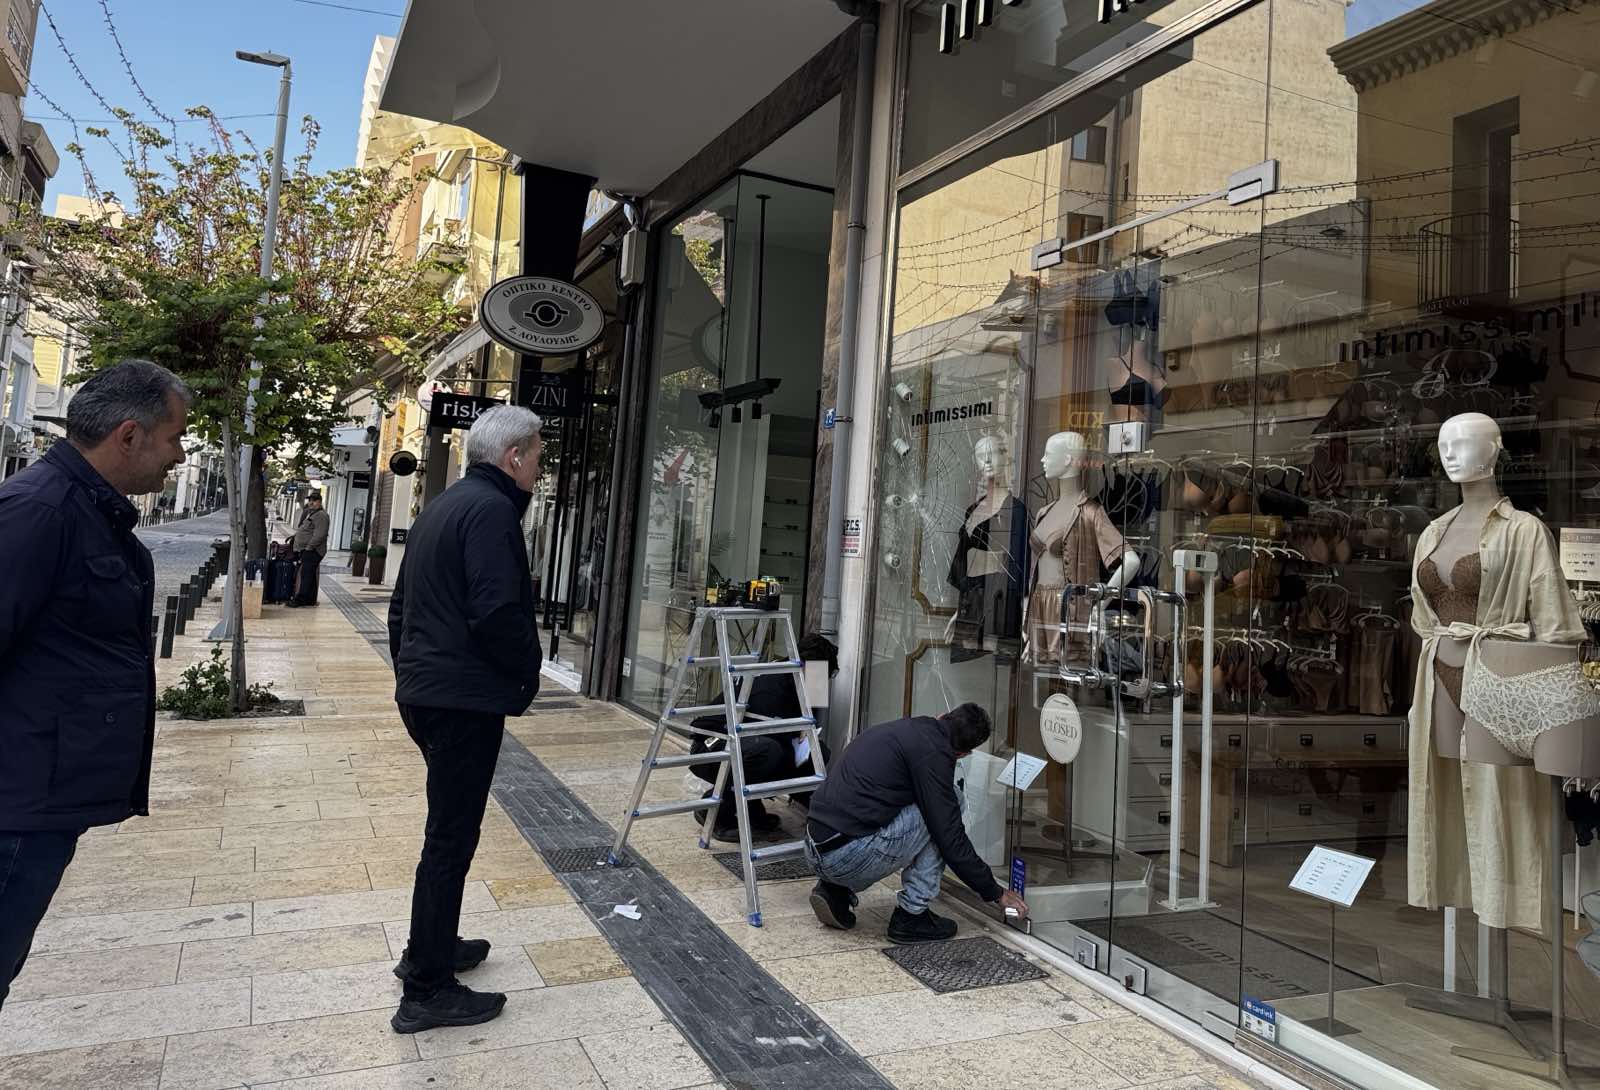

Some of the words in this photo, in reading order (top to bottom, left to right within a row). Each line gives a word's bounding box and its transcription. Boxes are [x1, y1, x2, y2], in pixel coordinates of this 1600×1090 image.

[502, 281, 547, 299] ΟΠΤΙΚΟ
[551, 284, 592, 312] ΚΕΝΤΡΟ
[531, 384, 568, 408] ZINI
[911, 401, 993, 427] intimissimi
[1044, 719, 1078, 739] CLOSED
